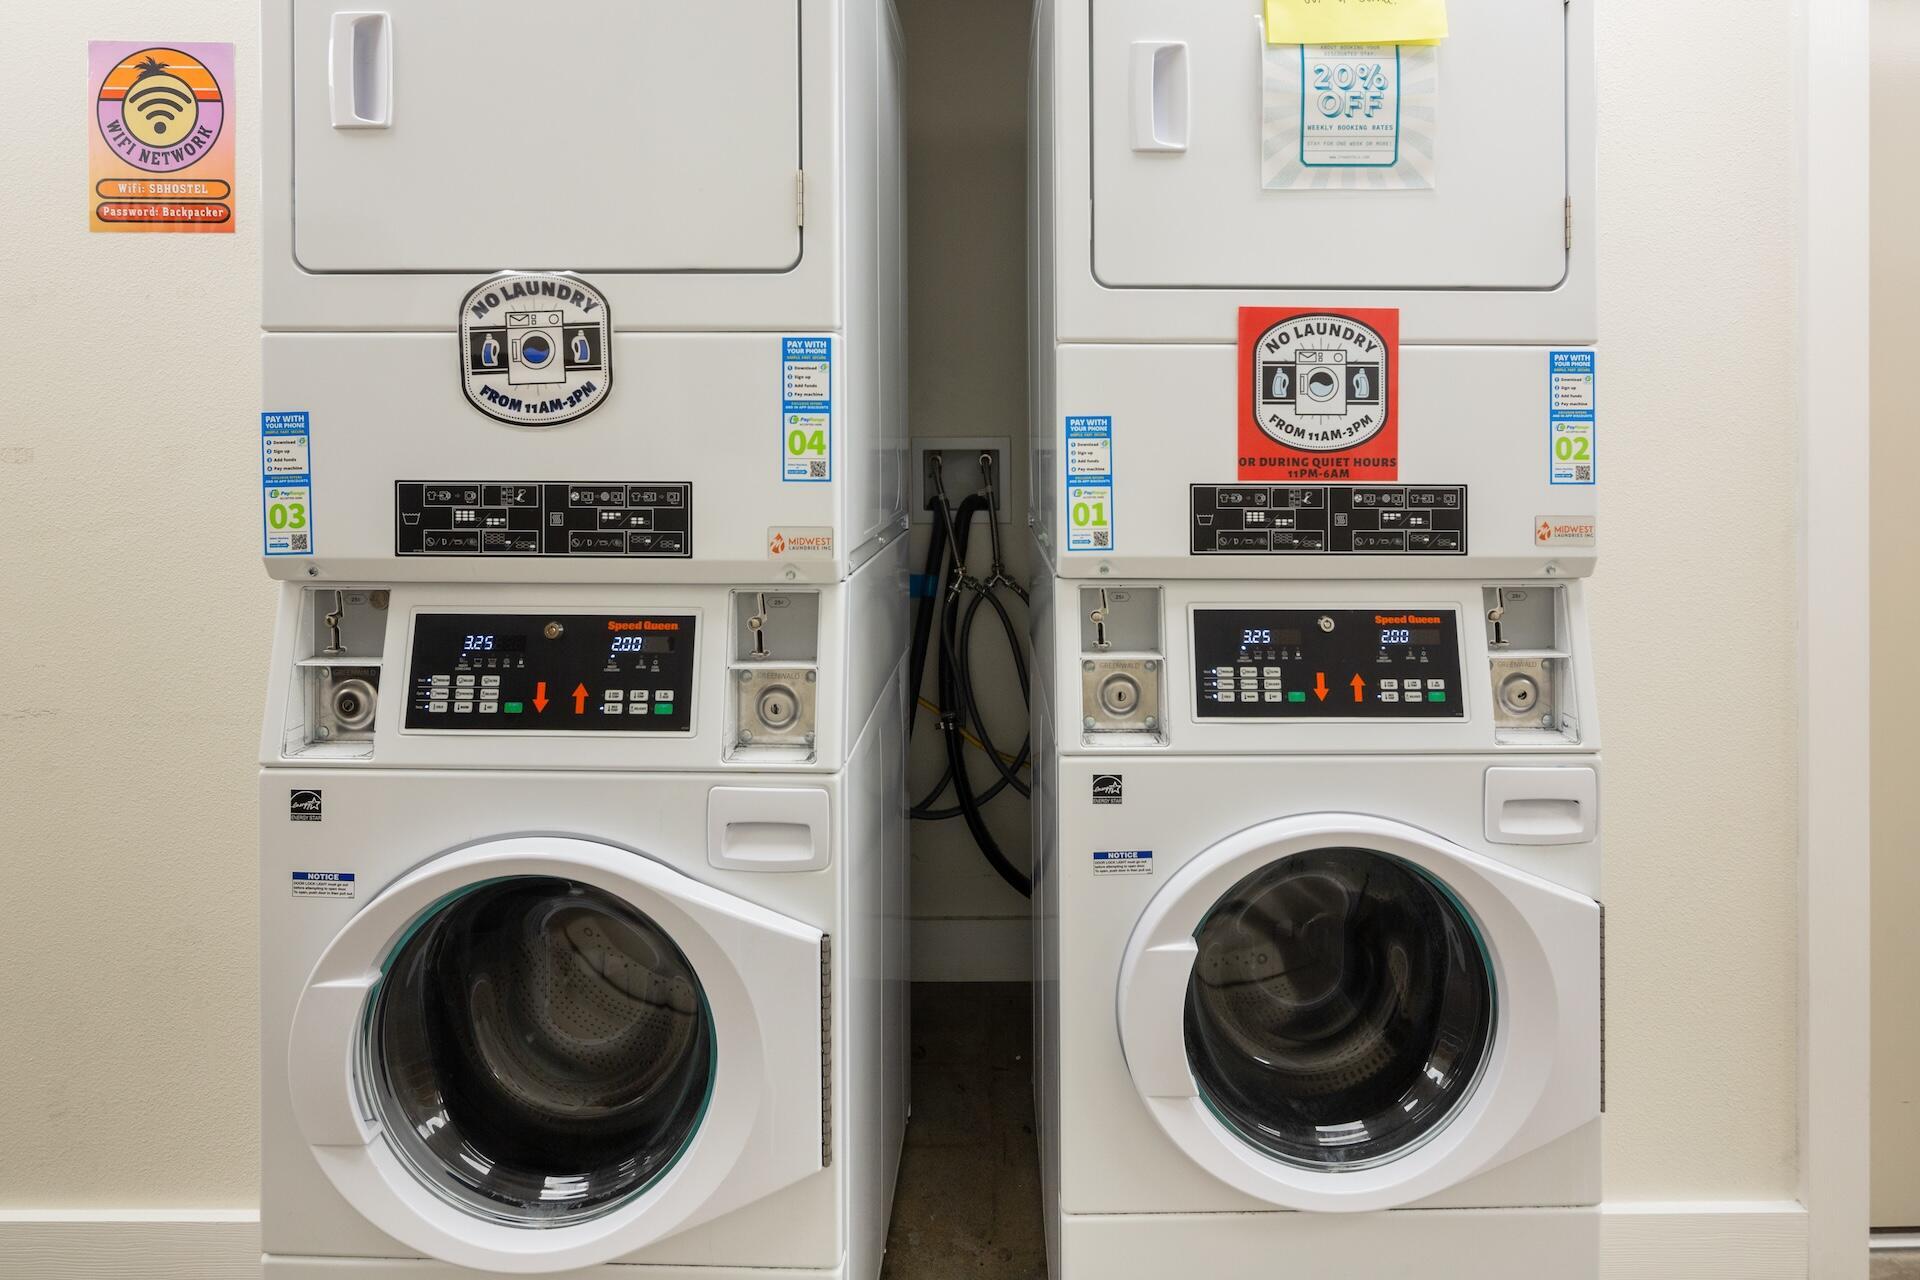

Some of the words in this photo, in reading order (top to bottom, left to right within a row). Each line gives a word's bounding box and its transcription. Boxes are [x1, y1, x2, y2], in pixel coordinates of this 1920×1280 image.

[1313, 64, 1389, 90] 20%
[1317, 91, 1385, 119] OFF
[106, 119, 137, 155] WIFI
[138, 124, 213, 166] NETWORK
[118, 183, 146, 194] Wifi:
[149, 183, 209, 194] SBHOSTEL
[103, 206, 159, 218] Password:
[162, 206, 224, 219] Backpacker
[471, 293, 501, 320] NO
[500, 281, 600, 314] LAUNDRY
[1264, 331, 1291, 355] NO
[1293, 322, 1378, 354] LAUNDRY
[479, 384, 522, 413] FROM
[525, 380, 597, 414] 11AM-3PM
[1269, 414, 1306, 439] FROM
[1308, 414, 1374, 441] 11AM-3PM
[788, 429, 826, 456] 04
[1555, 436, 1590, 461] 02
[1238, 457, 1256, 467] OR
[1259, 457, 1309, 467] DURING
[1312, 457, 1350, 468] QUIET
[1353, 457, 1396, 467] HOURS
[1288, 469, 1350, 479] 11PM-6AM
[269, 503, 306, 529] 03
[1073, 502, 1107, 527] 01
[1554, 525, 1593, 533] MIDWEST
[788, 537, 832, 546] MIDWEST
[608, 620, 643, 631] Speed
[644, 620, 679, 630] Queen
[1375, 615, 1407, 625] Speed
[1408, 615, 1441, 624] Queen
[464, 635, 494, 650] 3.25
[611, 637, 643, 651] 2.00
[1243, 630, 1271, 644] 3.25
[1381, 630, 1409, 643] 2.00
